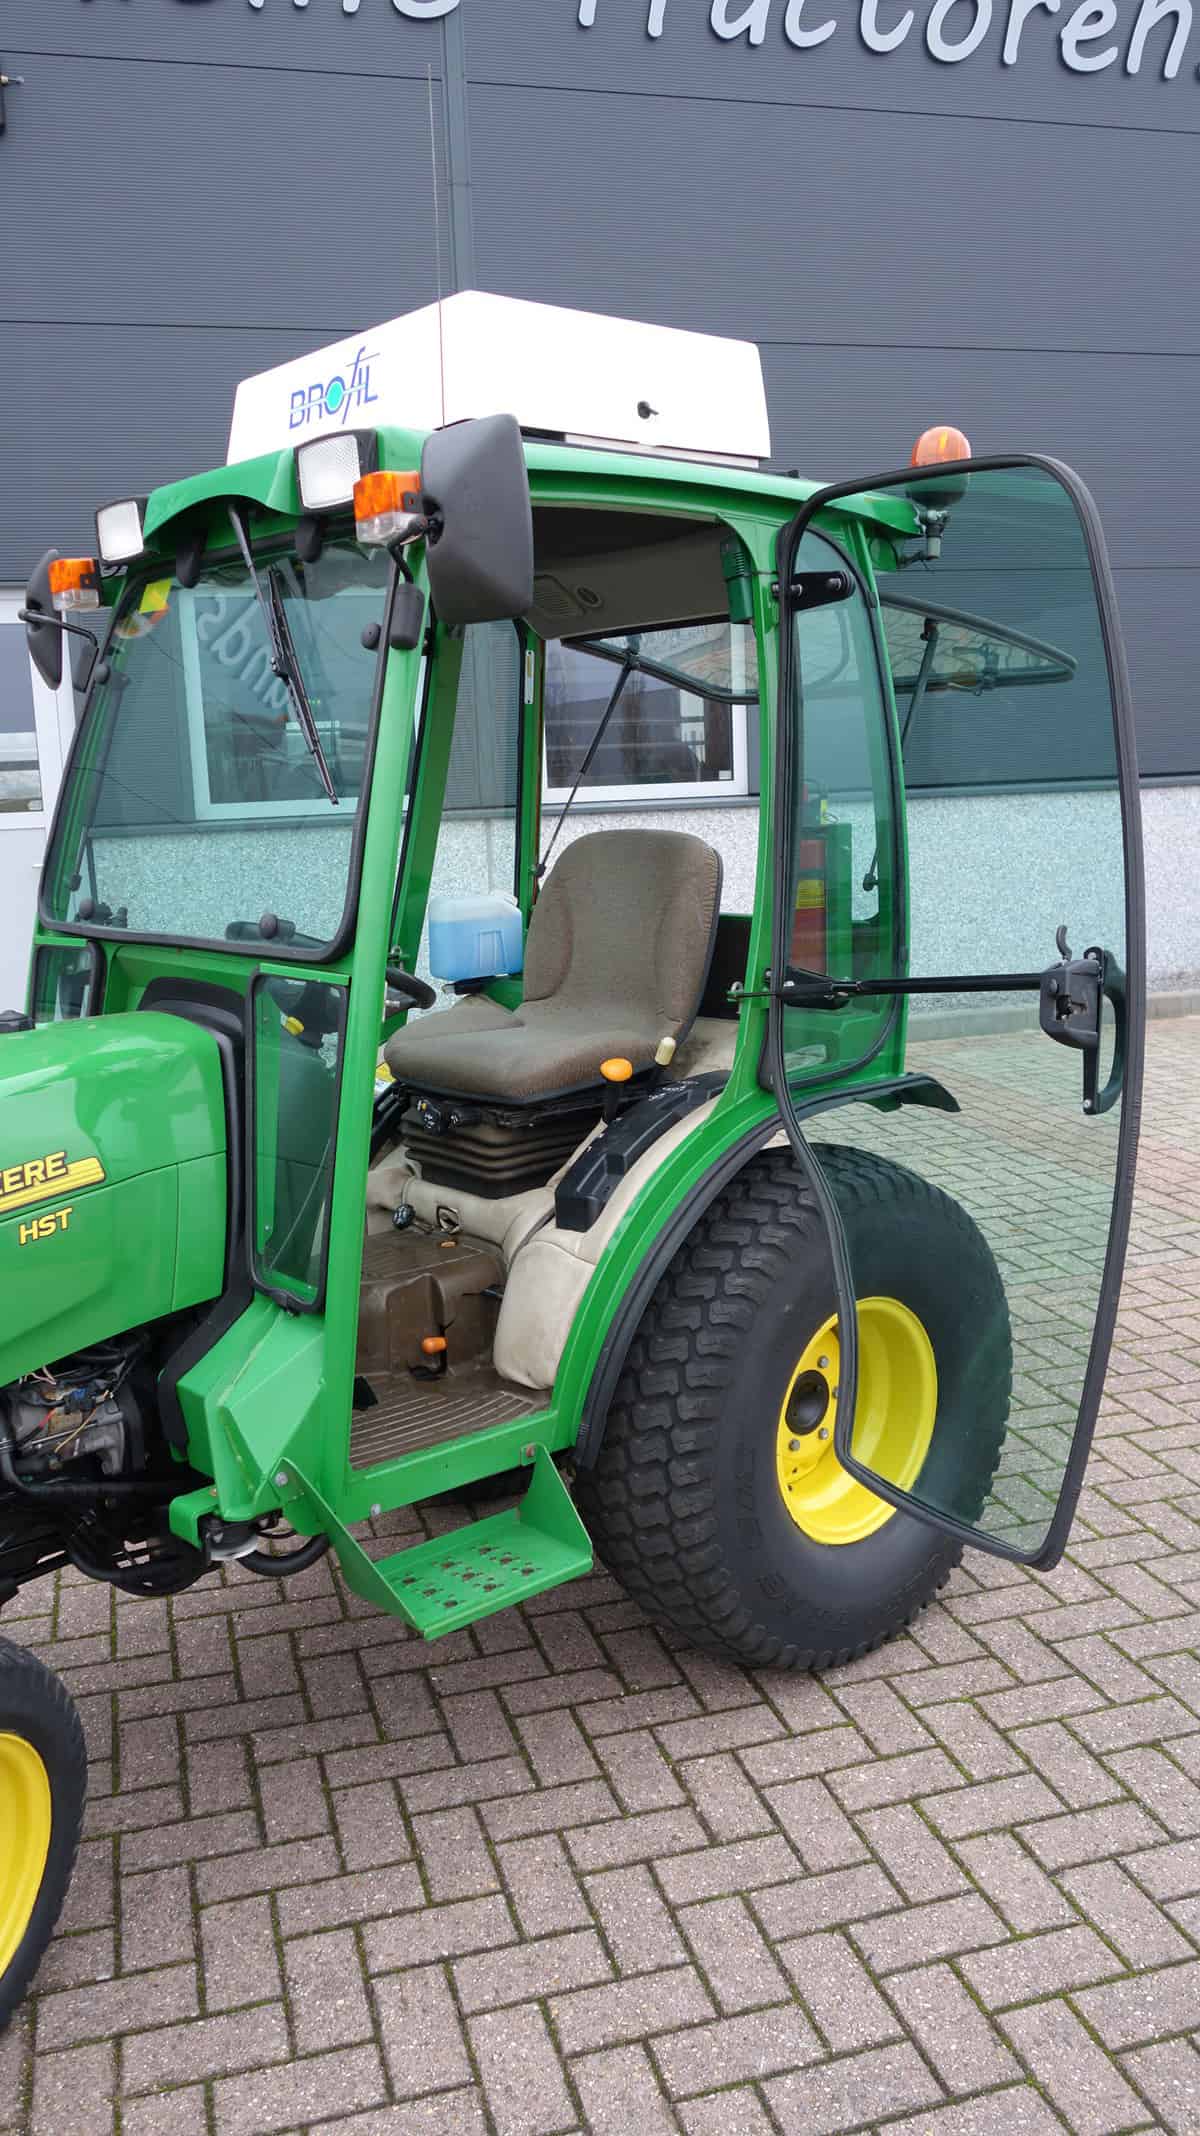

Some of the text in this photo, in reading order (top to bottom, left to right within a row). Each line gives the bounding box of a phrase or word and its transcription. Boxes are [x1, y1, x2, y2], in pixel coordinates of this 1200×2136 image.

[577, 0, 1194, 79] acoren
[0, 1150, 68, 1195] ERE
[19, 1206, 73, 1245] HST
